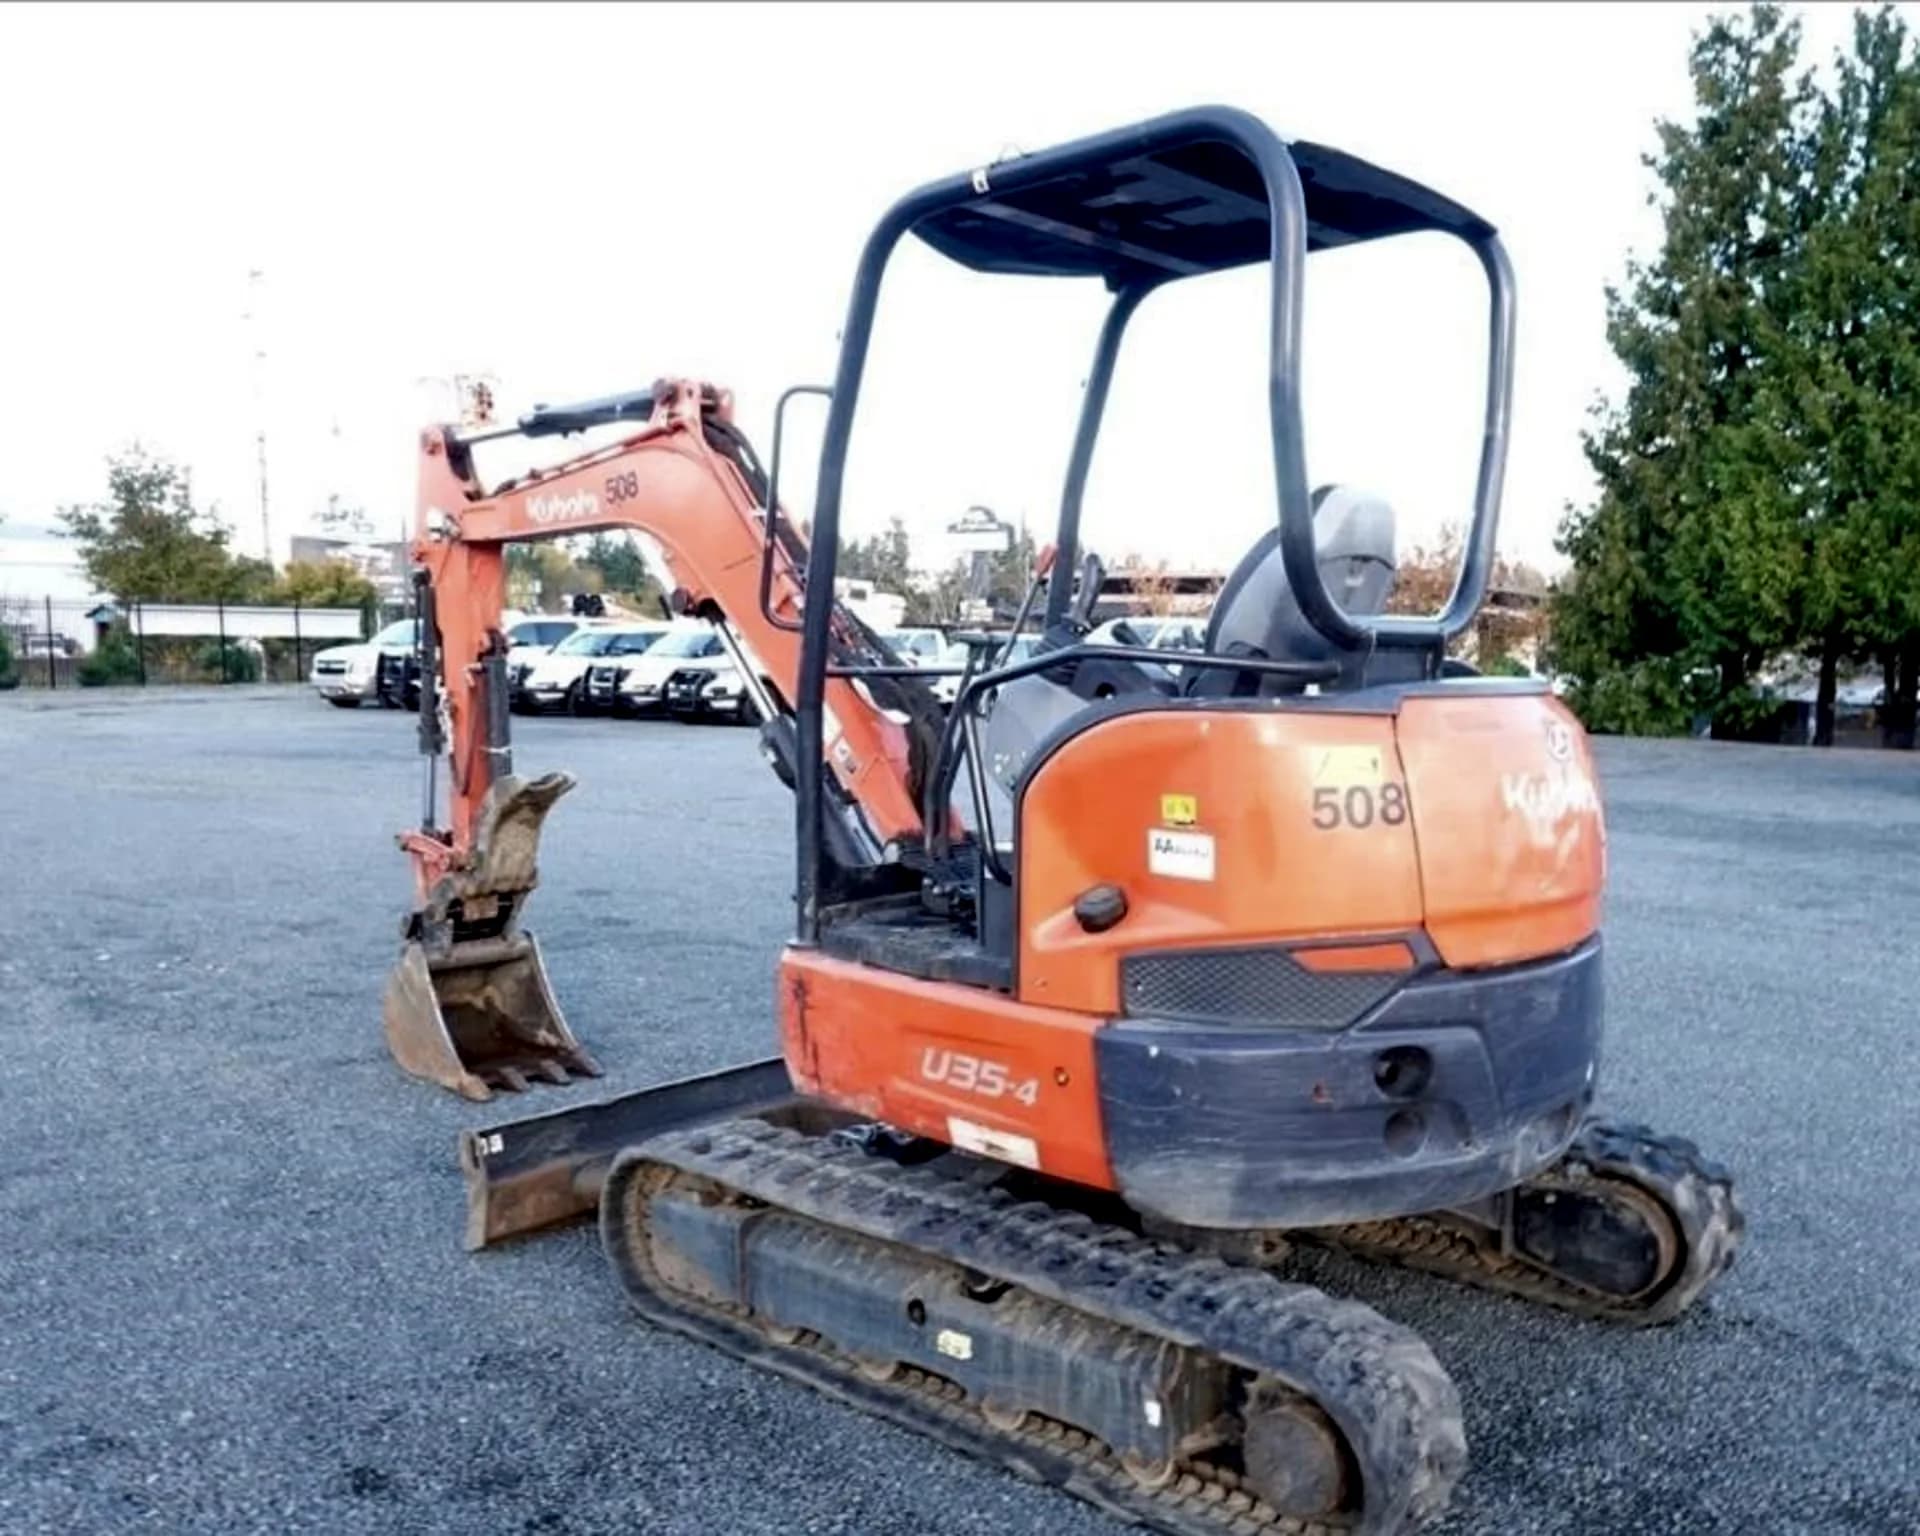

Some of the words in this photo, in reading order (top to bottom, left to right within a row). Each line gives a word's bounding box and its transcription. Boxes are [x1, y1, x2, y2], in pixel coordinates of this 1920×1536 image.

[605, 471, 639, 504] 508
[1311, 782, 1406, 831] 508
[921, 1047, 1039, 1106] U35-4
